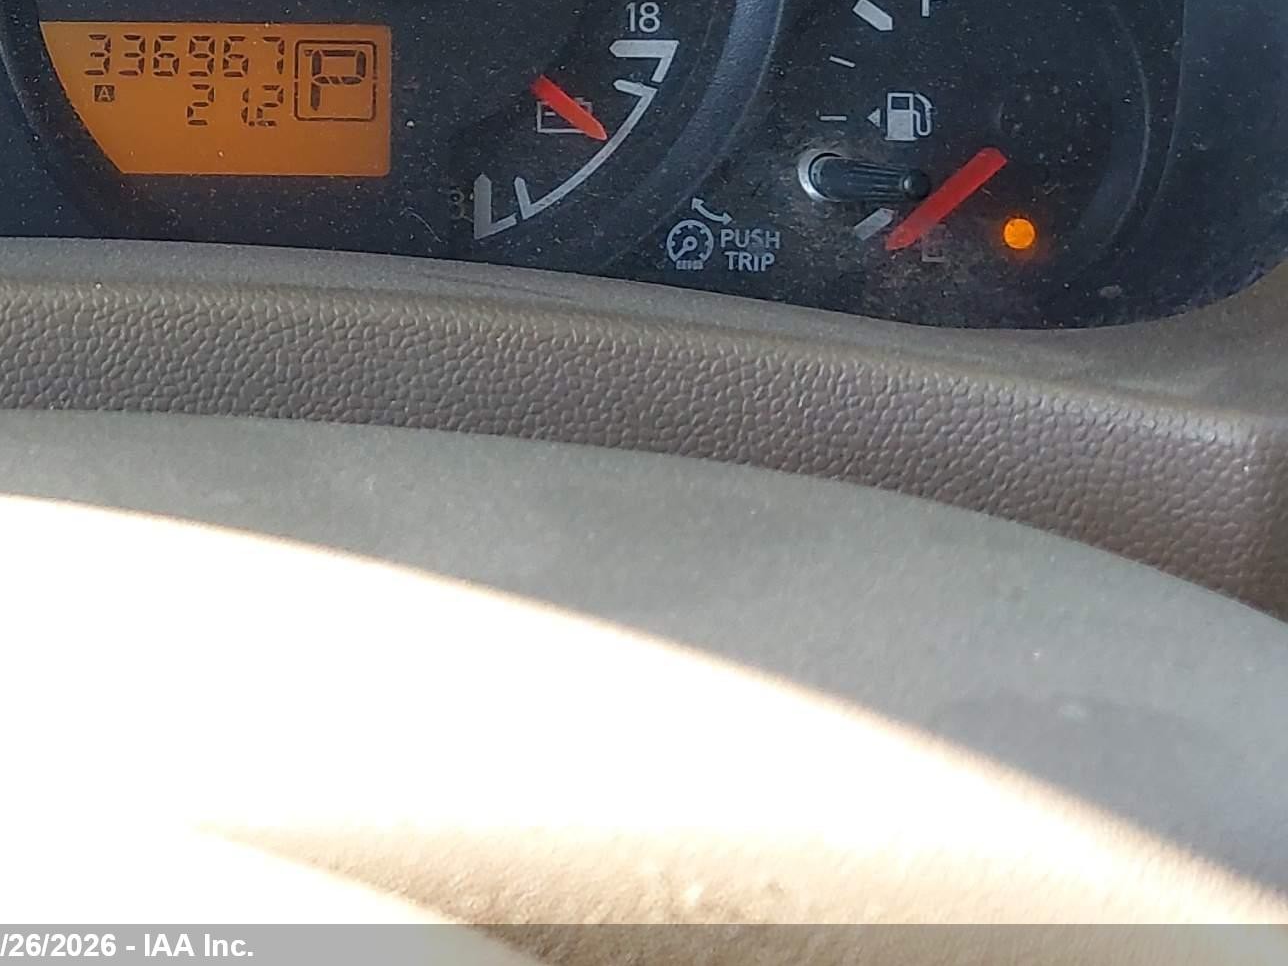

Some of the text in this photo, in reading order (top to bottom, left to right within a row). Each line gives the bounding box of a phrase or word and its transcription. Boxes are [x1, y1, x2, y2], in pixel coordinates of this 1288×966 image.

[626, 2, 660, 32] 18
[84, 34, 285, 77] 336967
[305, 49, 367, 111] P
[720, 228, 780, 251] PUSH
[724, 251, 774, 272] TRIP
